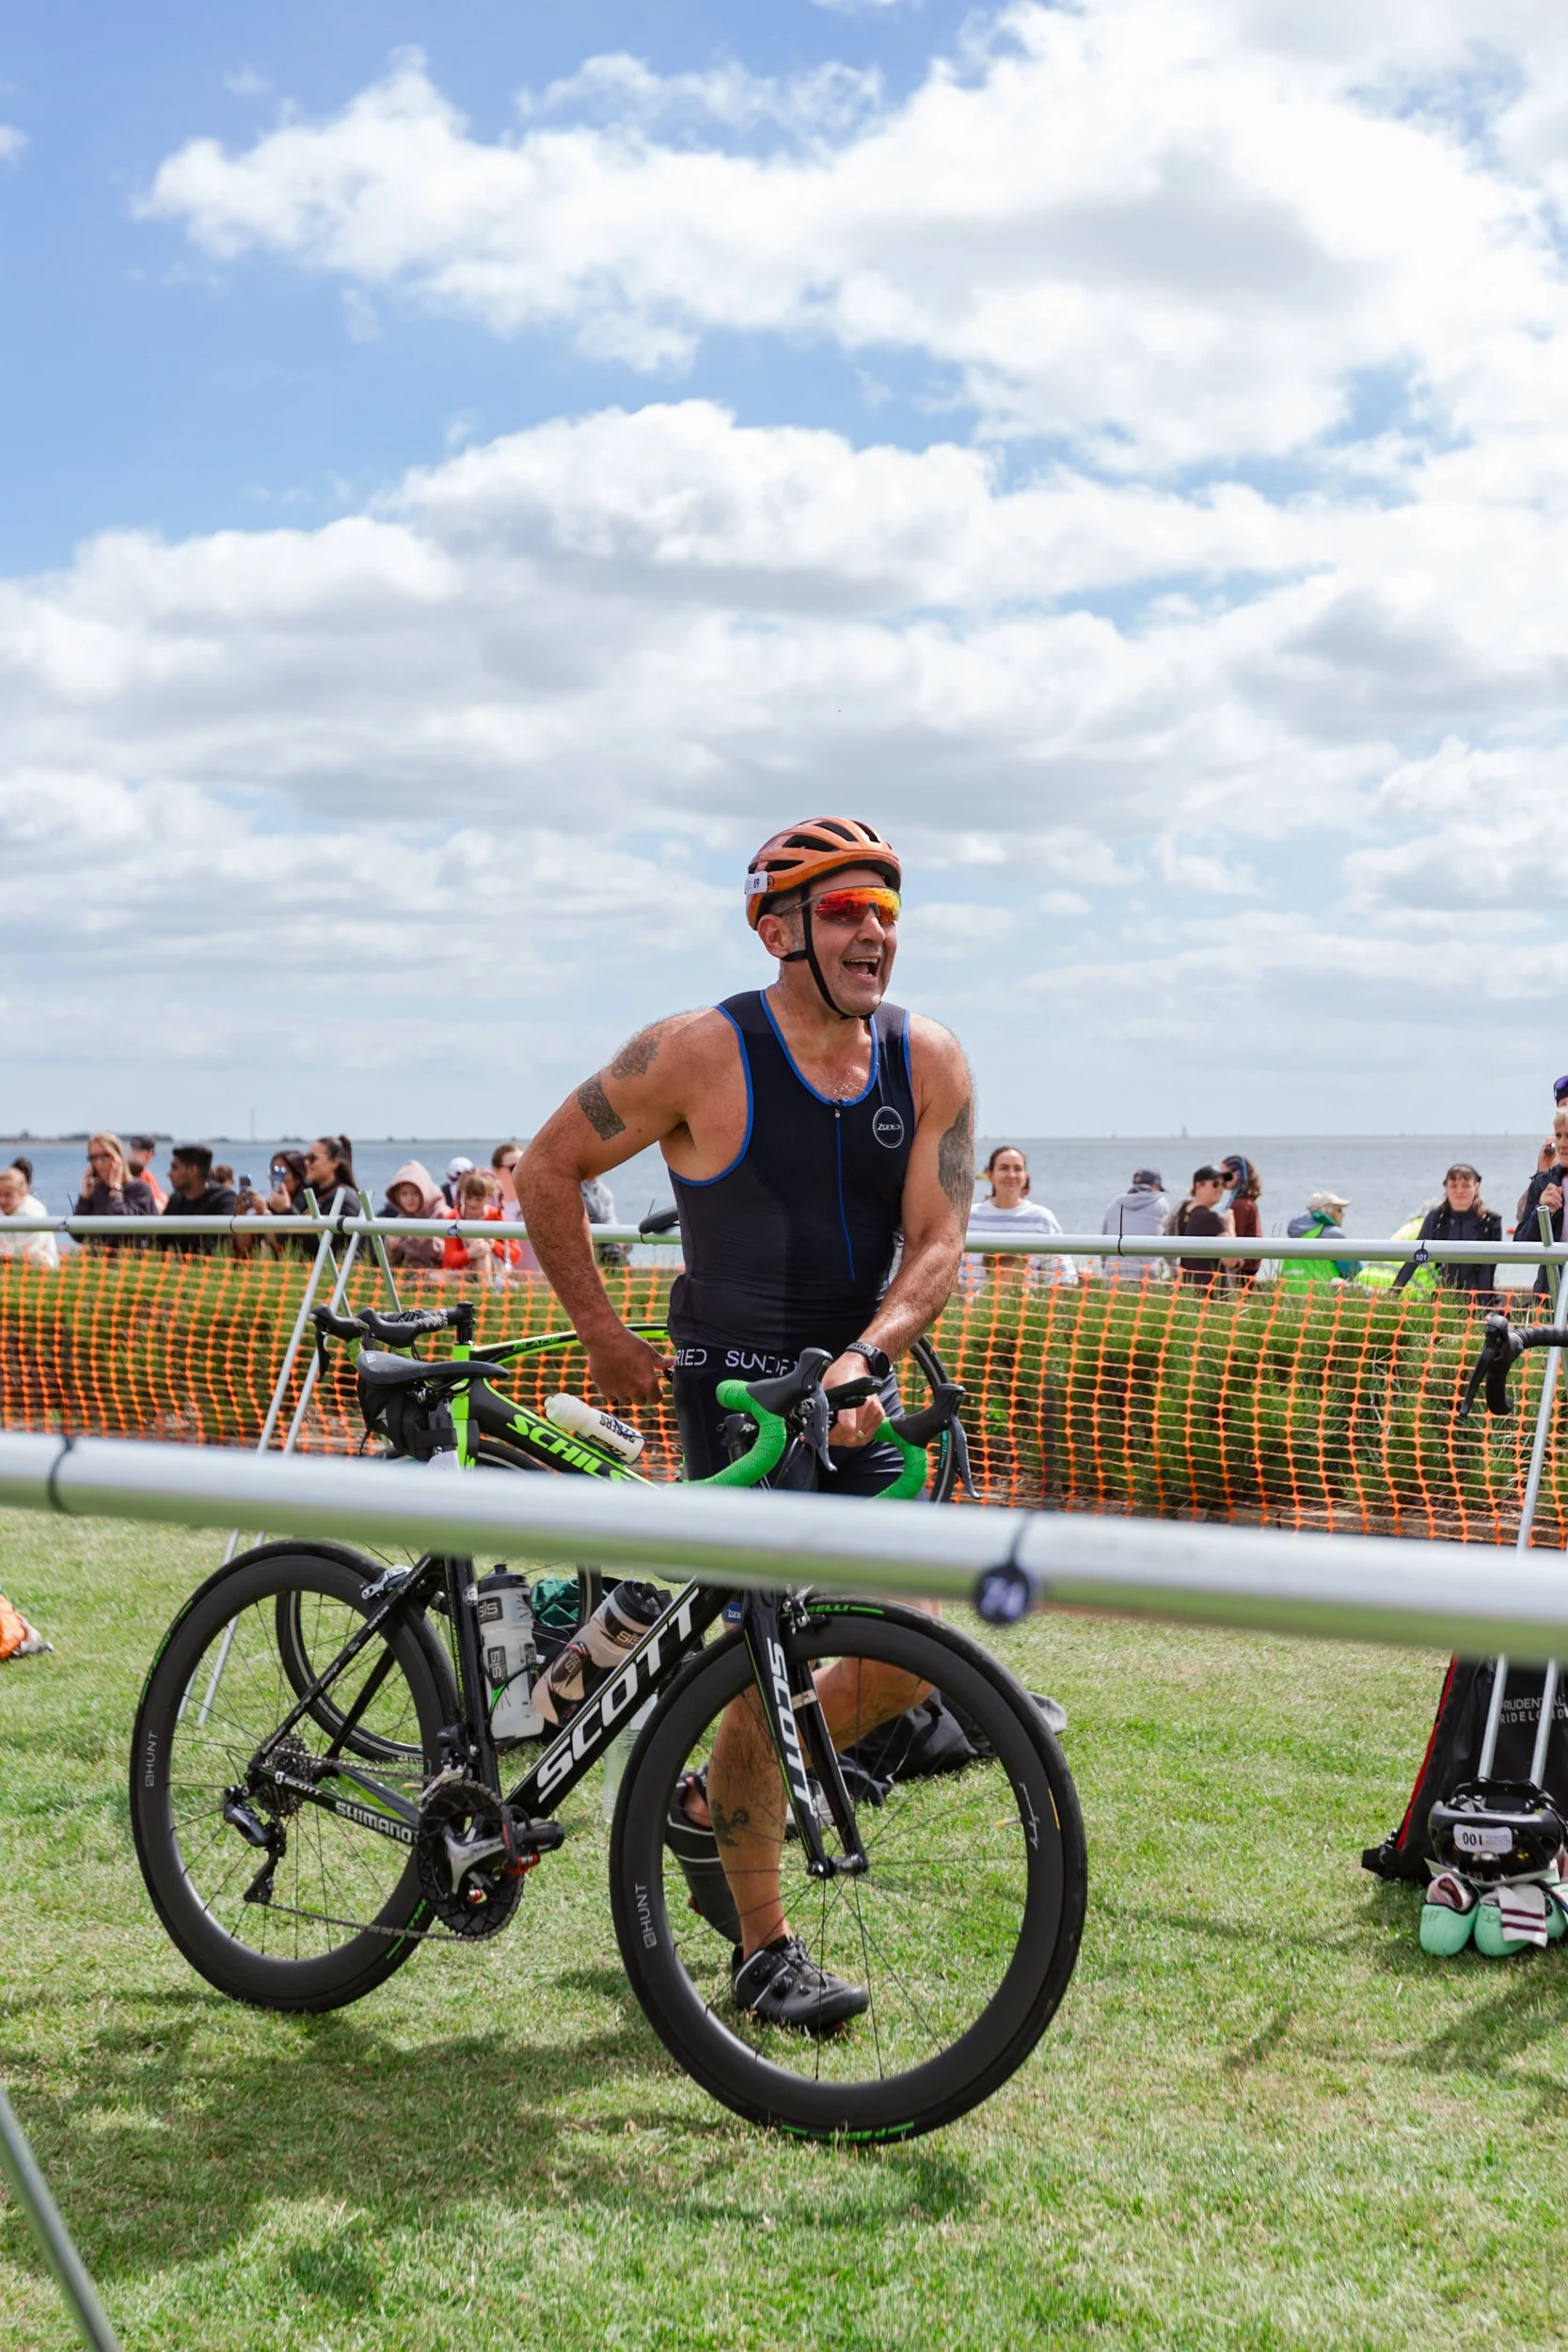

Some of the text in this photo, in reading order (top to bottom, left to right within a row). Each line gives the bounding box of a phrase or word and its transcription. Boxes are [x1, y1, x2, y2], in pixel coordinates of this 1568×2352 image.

[1416, 1253, 1427, 1262] 101
[537, 1587, 699, 1804] SCOTT
[767, 1636, 817, 1818] SCOTT
[146, 1730, 158, 1772] HUNT
[284, 1778, 323, 1796] SCOTT
[335, 1801, 412, 1844] SHIMANO
[634, 1882, 653, 1933] HUNT
